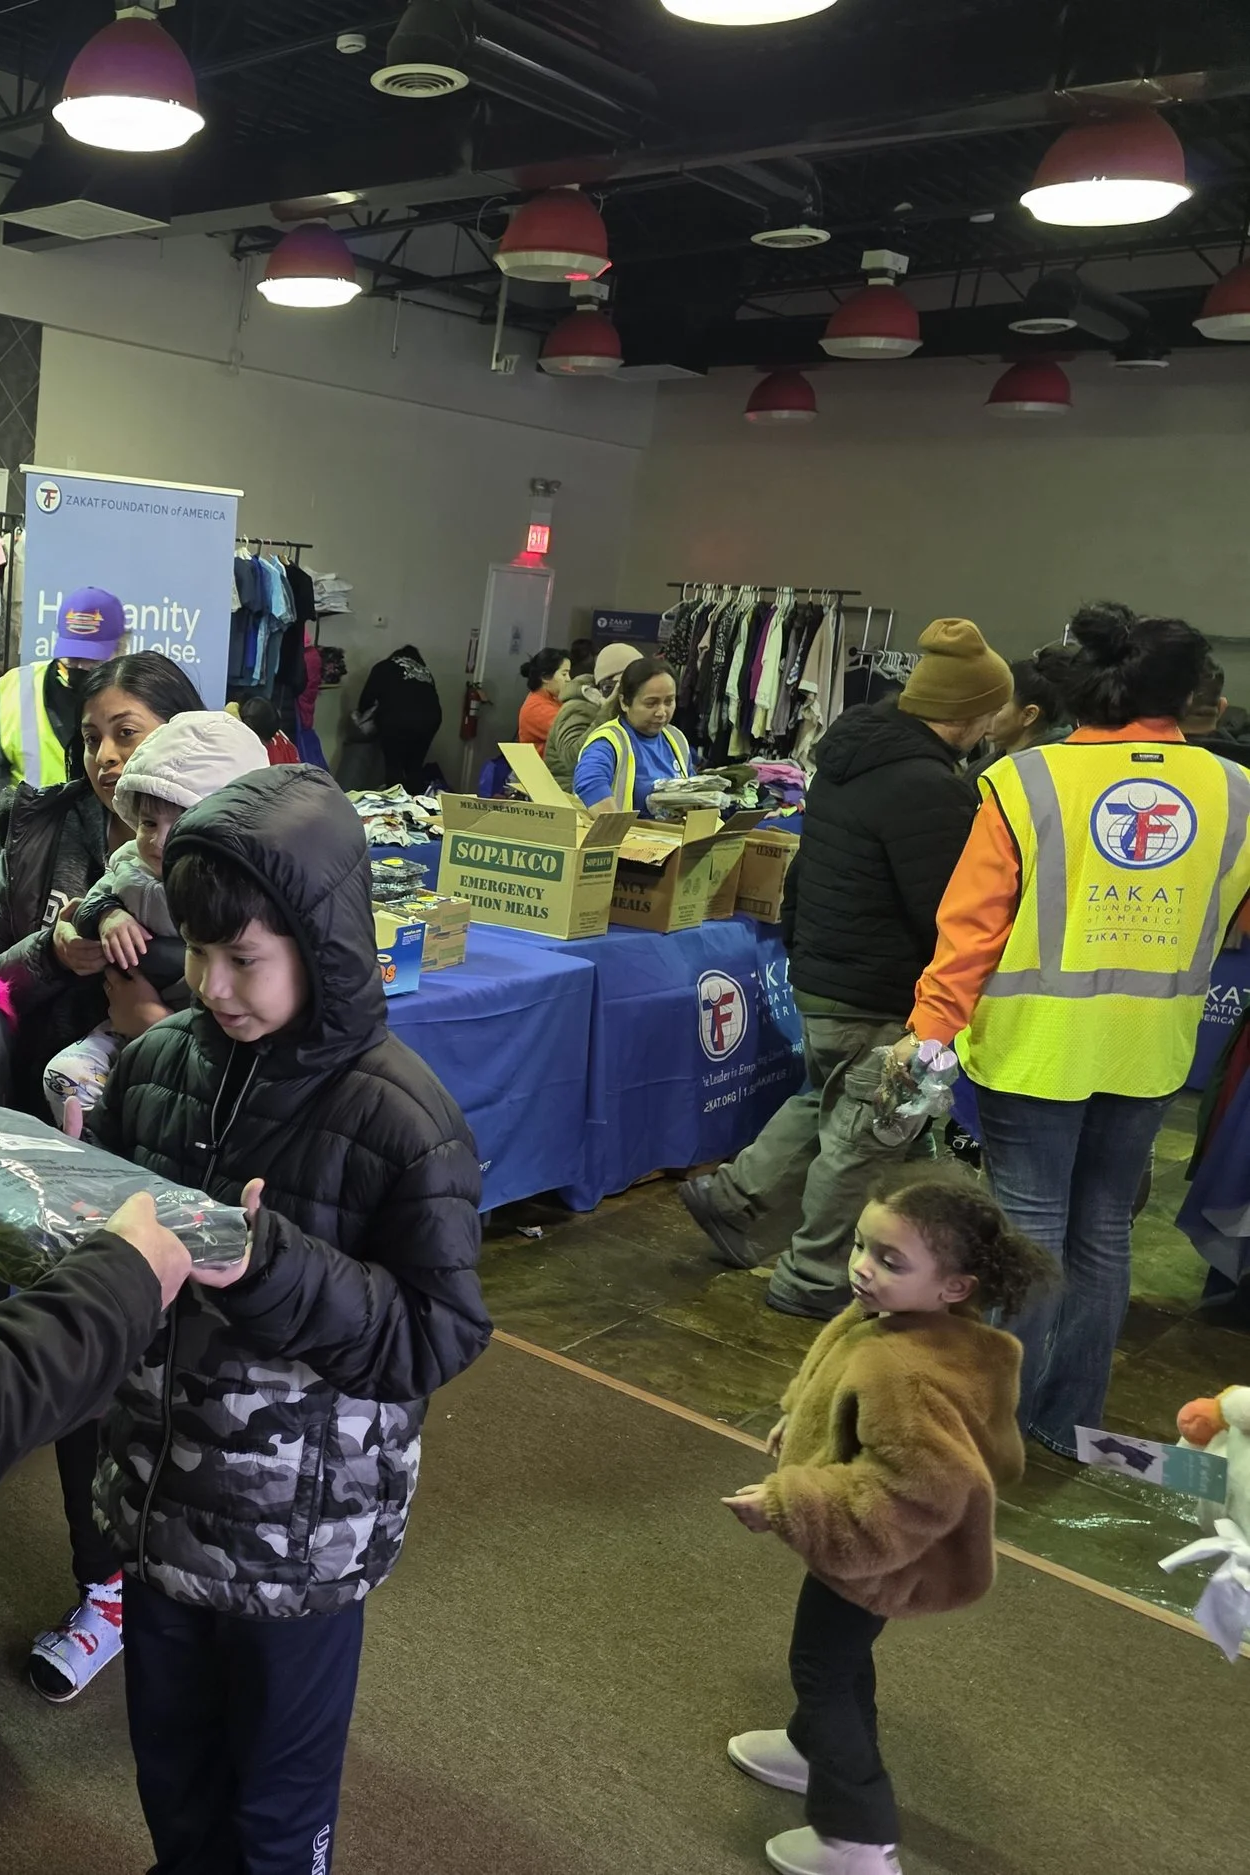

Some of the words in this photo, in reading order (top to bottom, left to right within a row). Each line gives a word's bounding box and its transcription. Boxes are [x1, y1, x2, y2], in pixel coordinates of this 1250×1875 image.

[66, 494, 100, 508] ZAKAT
[100, 498, 169, 516] FOUNDATION
[170, 506, 182, 517] of
[182, 506, 226, 521] AMERICA
[37, 589, 200, 641] Hanity
[609, 618, 633, 626] ZAKAT
[460, 801, 491, 812] MEALS,
[493, 804, 555, 820] READY-TO-EAT
[456, 841, 557, 874] SOPAKCO
[459, 875, 545, 901] EMERGENCY
[1088, 885, 1184, 905] ZAKAT
[505, 902, 549, 920] MEALS
